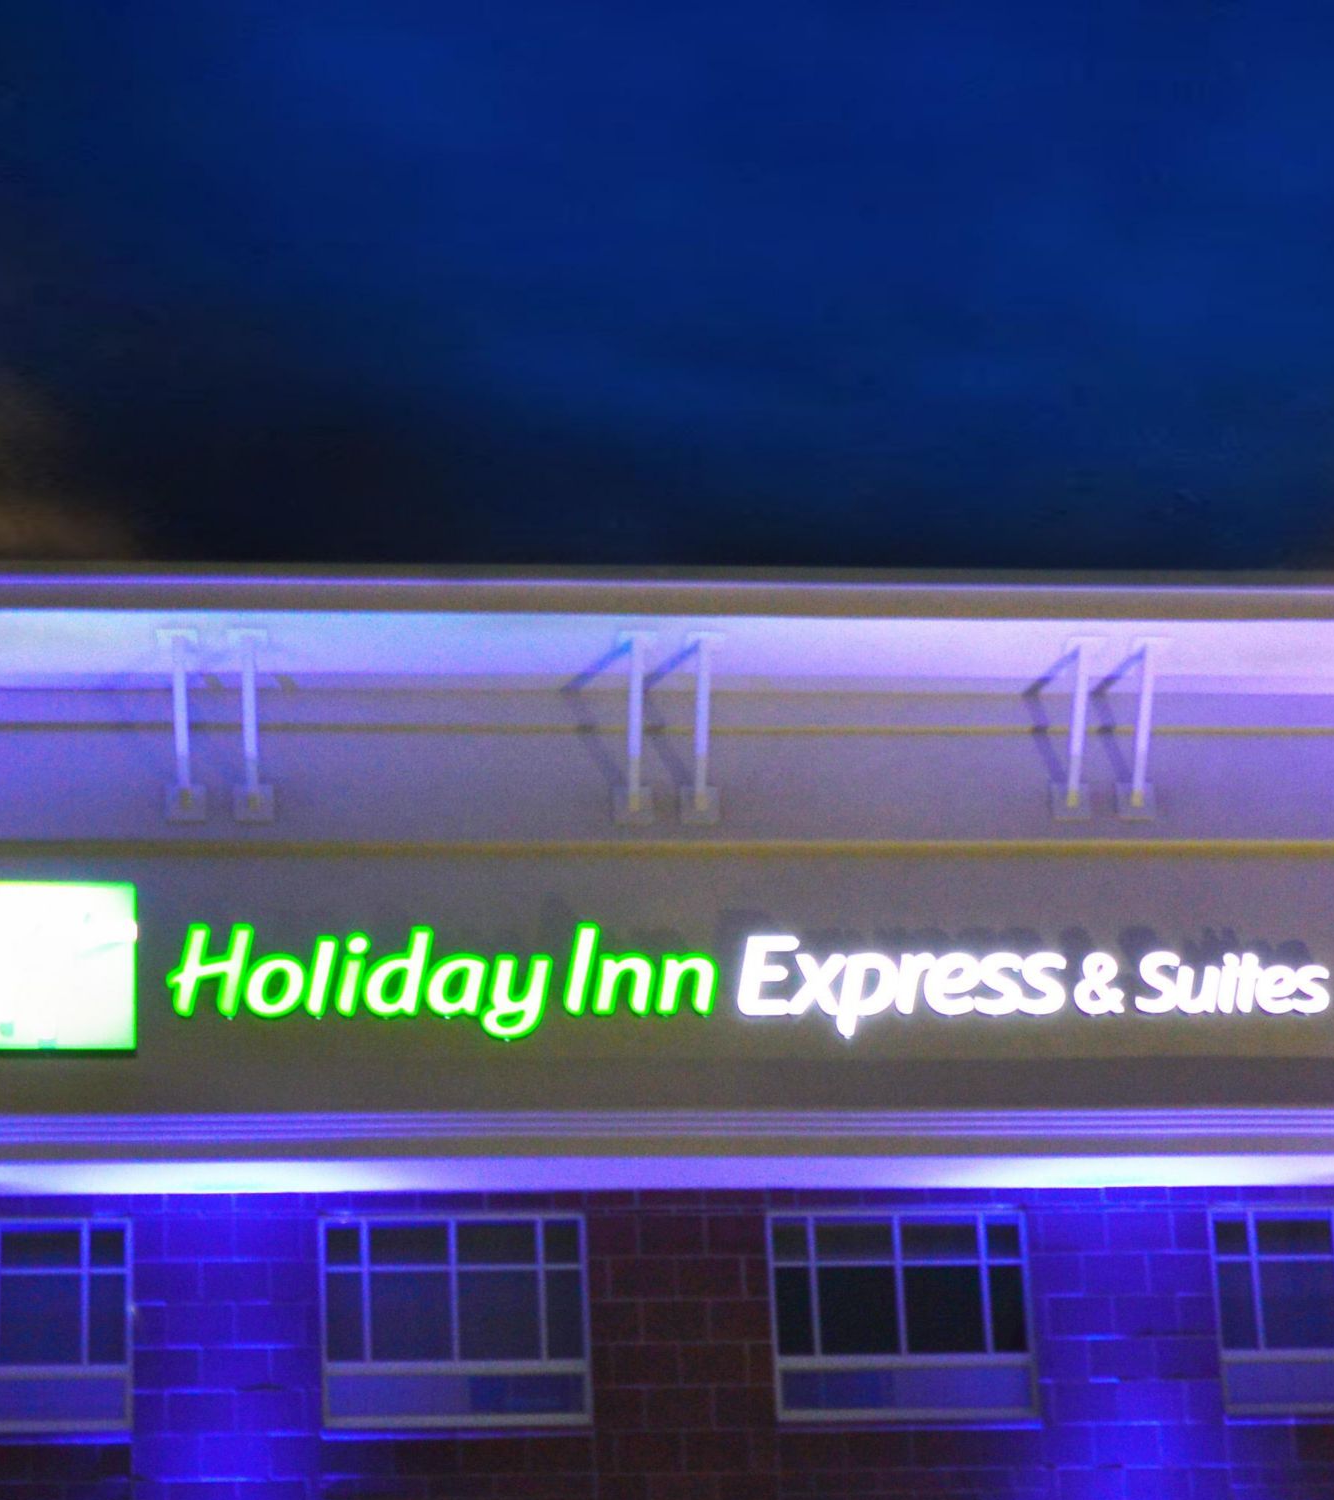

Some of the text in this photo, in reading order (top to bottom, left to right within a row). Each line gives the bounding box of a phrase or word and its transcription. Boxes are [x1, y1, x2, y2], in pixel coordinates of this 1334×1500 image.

[167, 922, 1330, 1038] Holiday Inn Express & Suites
